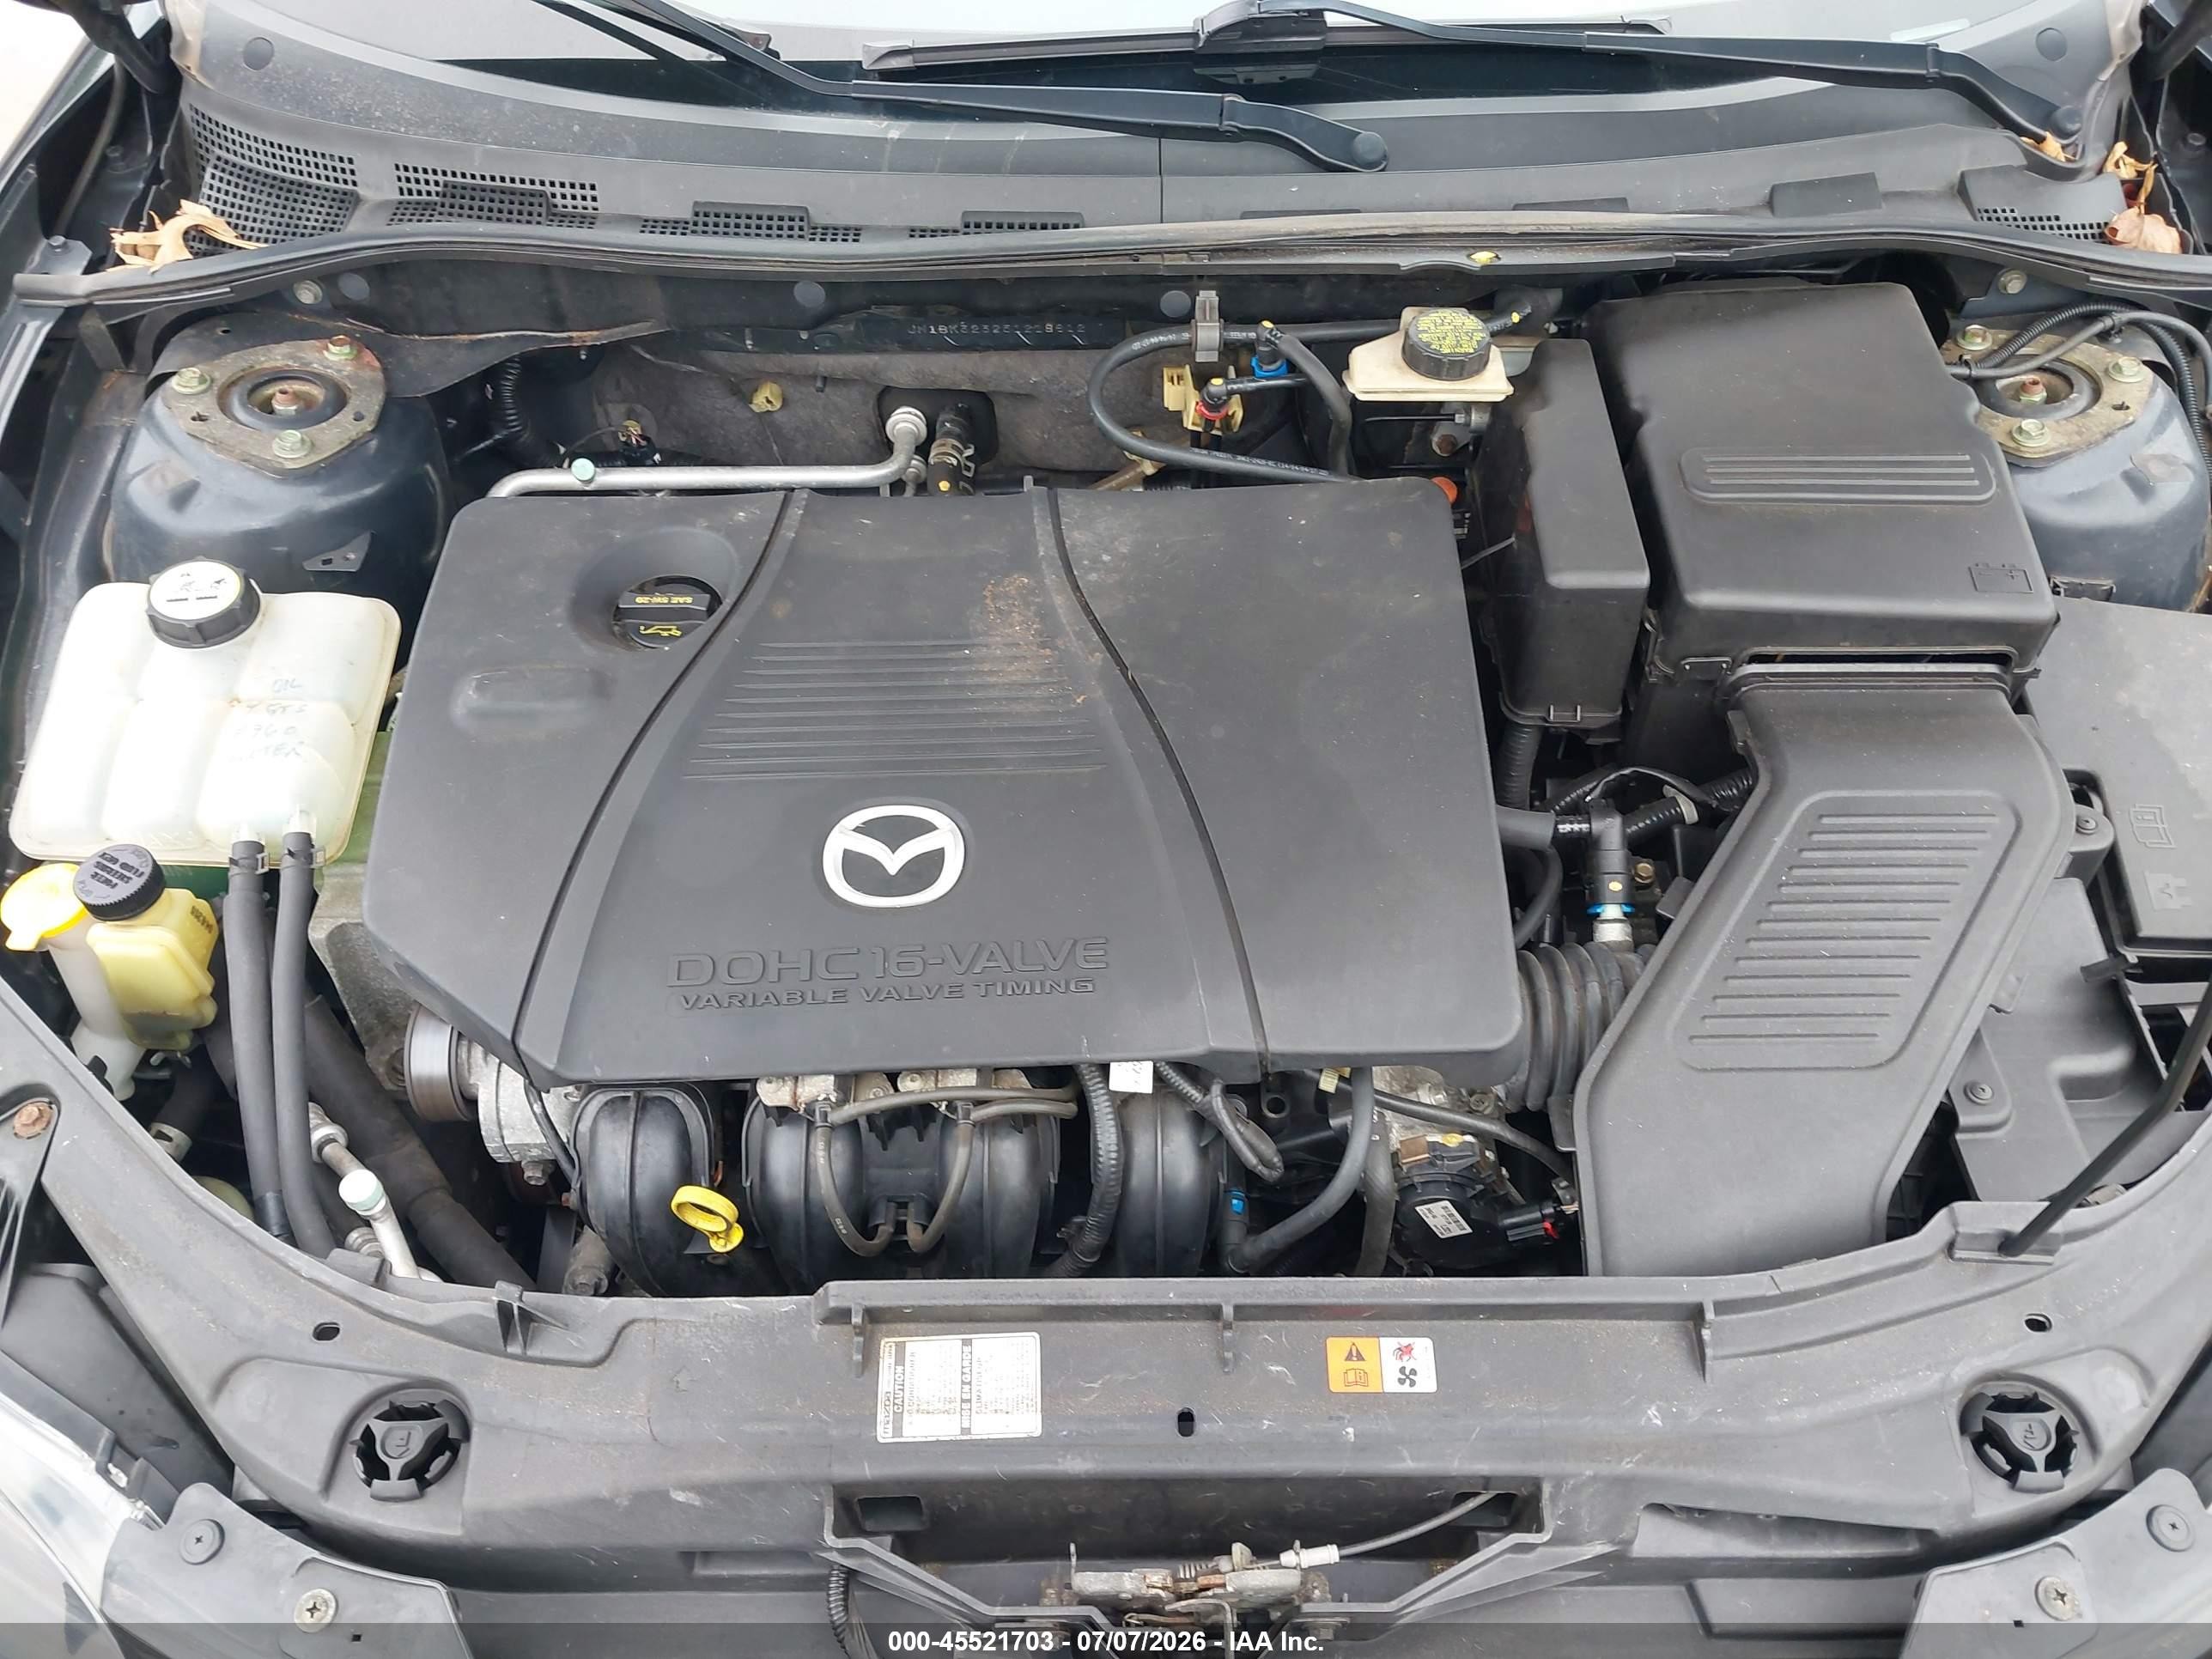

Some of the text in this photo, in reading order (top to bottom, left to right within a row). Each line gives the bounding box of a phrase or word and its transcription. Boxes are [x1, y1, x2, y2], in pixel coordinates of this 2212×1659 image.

[635, 595, 694, 604] SAE 5W-20
[666, 936, 1110, 988] DOHC 16-VALVE
[680, 976, 1097, 1011] VARIABLE VALVE TIMING
[893, 1365, 905, 1413] CAUTION
[961, 1345, 972, 1429] MISE EN GARDE
